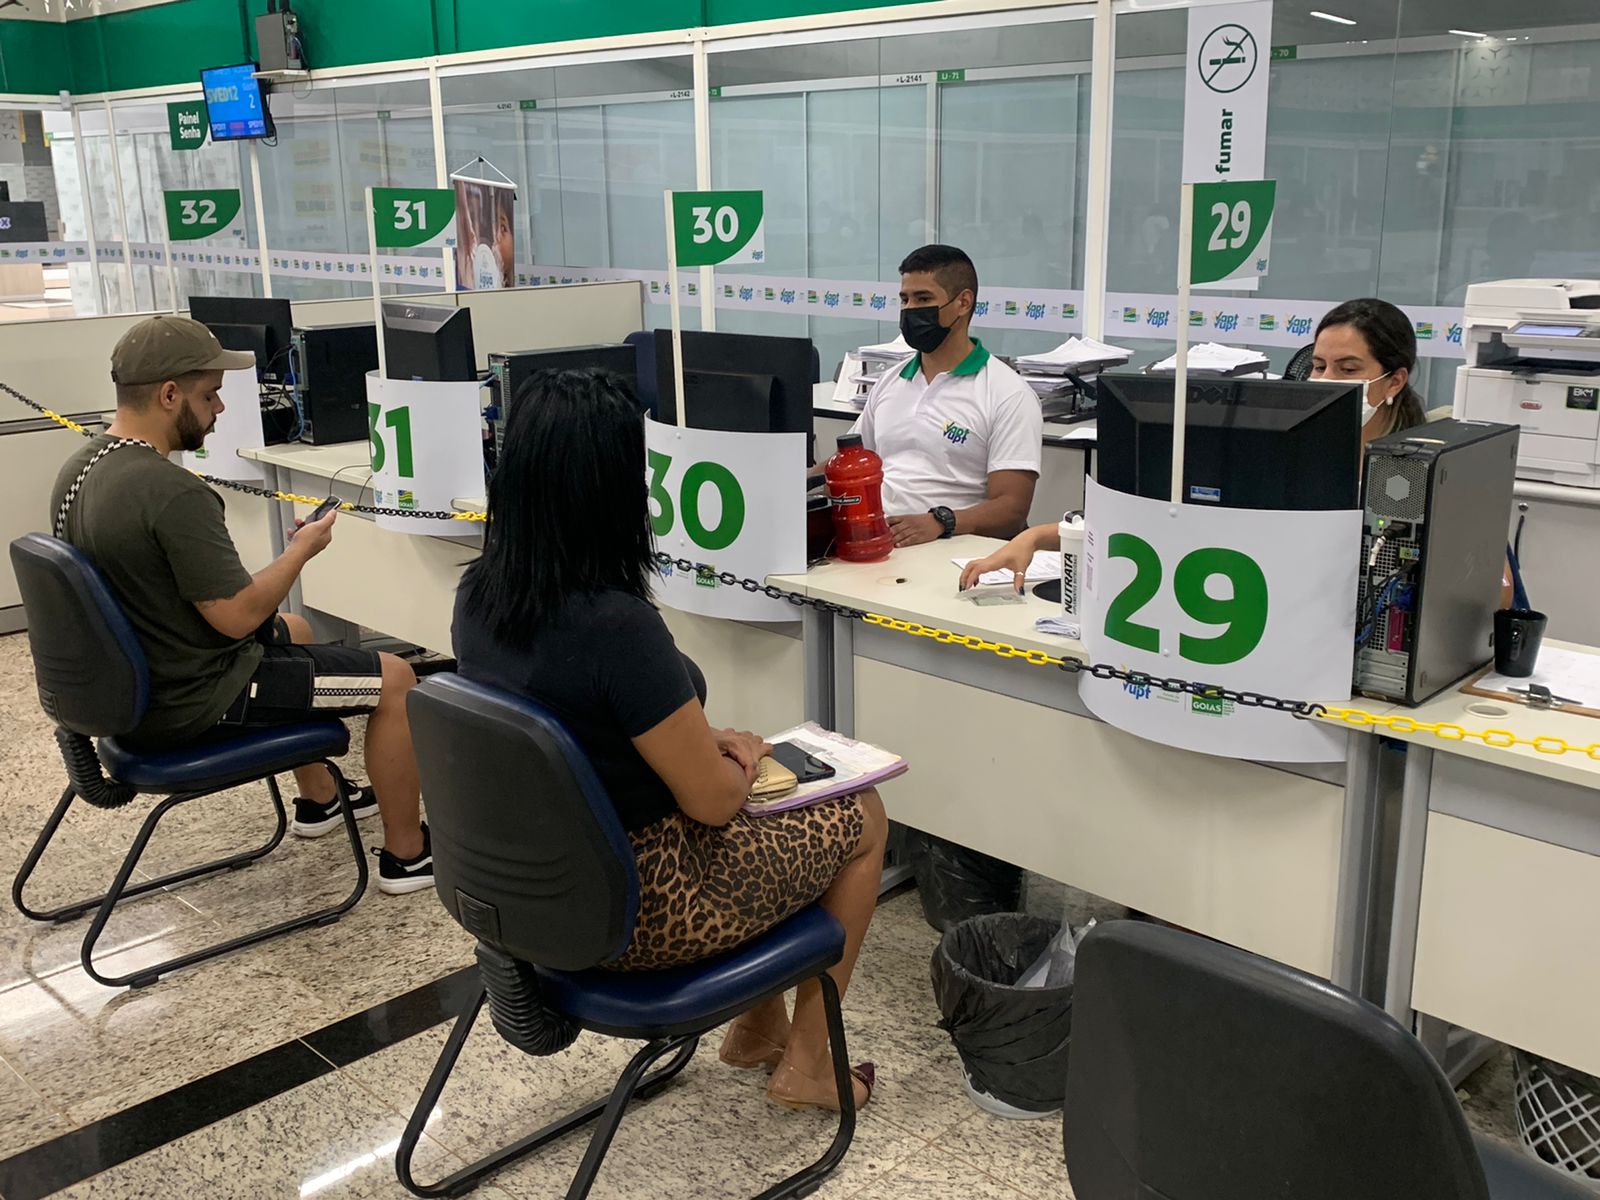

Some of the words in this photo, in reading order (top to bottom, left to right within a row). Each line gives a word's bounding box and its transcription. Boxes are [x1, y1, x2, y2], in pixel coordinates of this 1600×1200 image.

[178, 111, 200, 125] Painel
[248, 94, 256, 109] 2
[180, 126, 201, 139] Senha
[1216, 109, 1232, 174] fumar
[180, 200, 218, 225] 32
[393, 200, 427, 230] 31
[692, 206, 739, 244] 30
[1208, 200, 1251, 252] 29
[648, 448, 746, 551] 30
[1064, 552, 1073, 615] NUTRATA
[1104, 532, 1269, 665] 29
[1193, 701, 1222, 713] GOIAS
